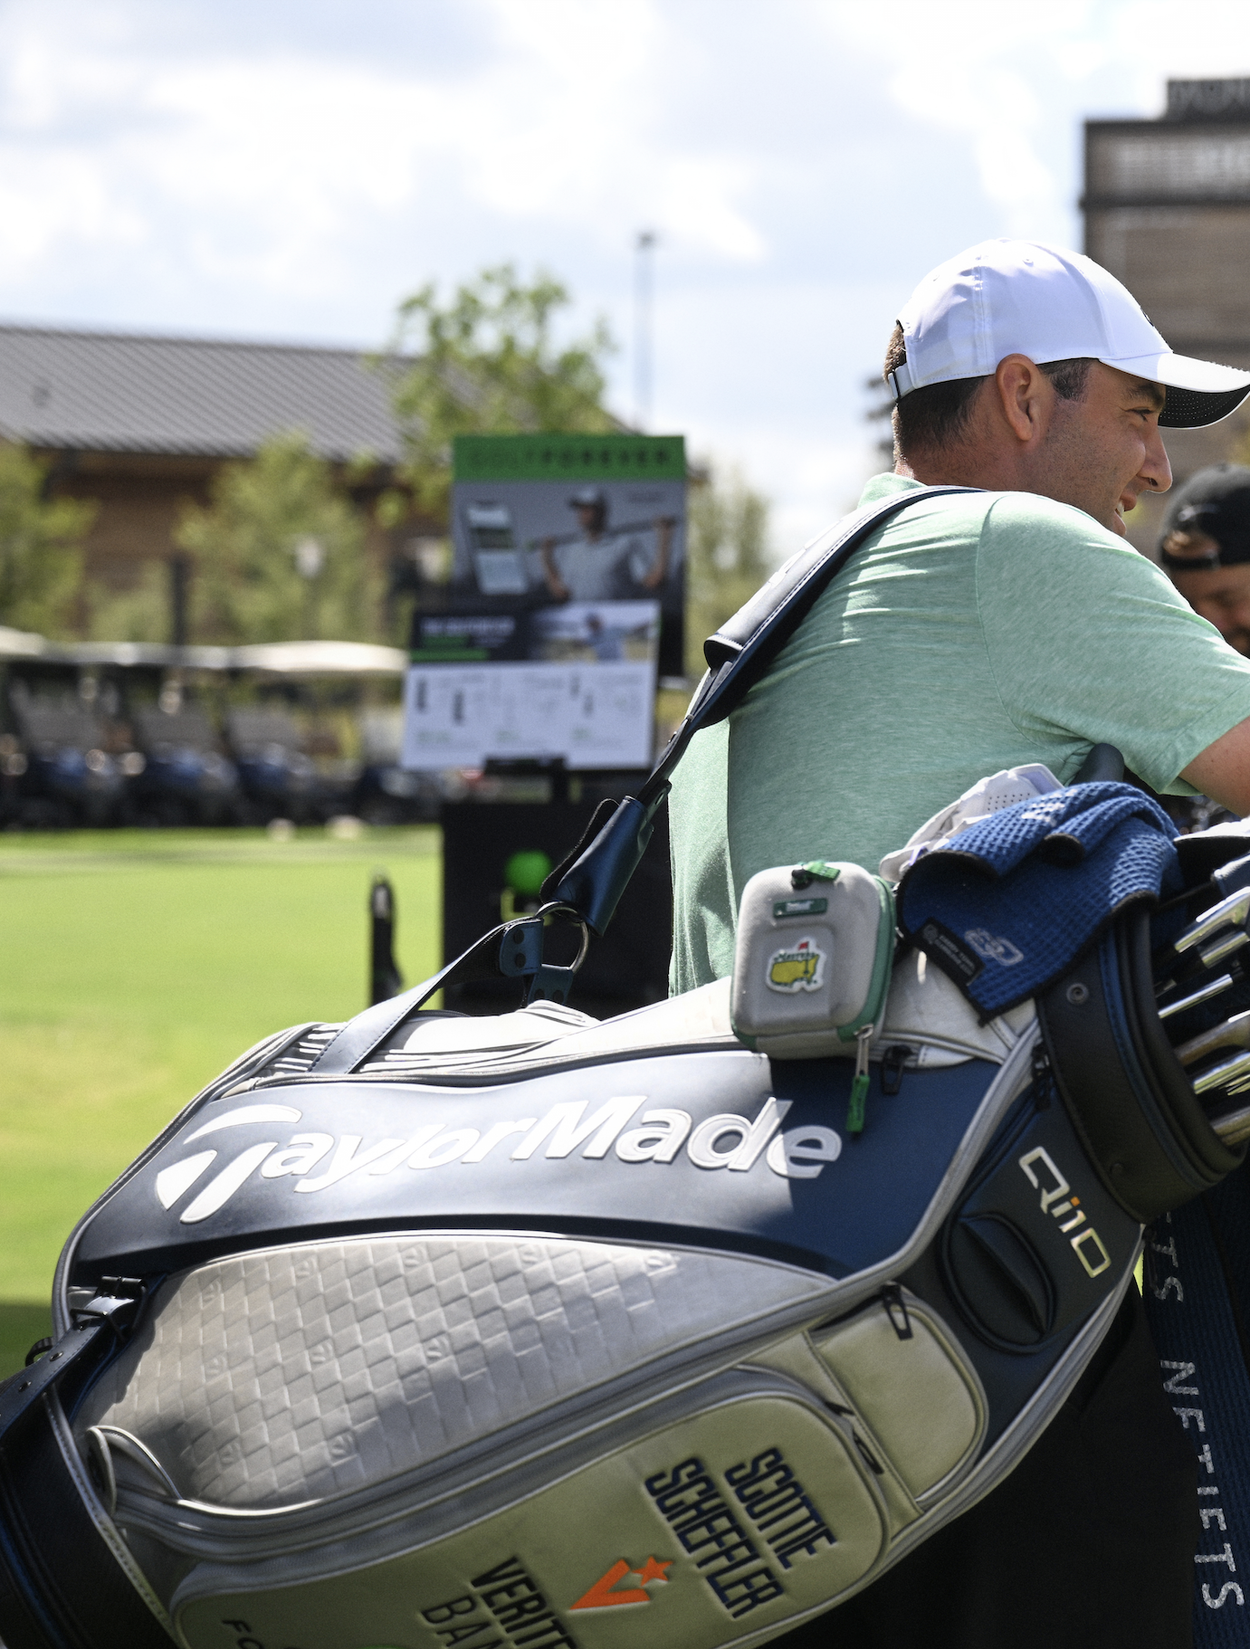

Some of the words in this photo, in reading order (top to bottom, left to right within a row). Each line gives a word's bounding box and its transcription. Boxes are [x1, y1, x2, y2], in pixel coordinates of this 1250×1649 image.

[156, 1094, 842, 1223] TaylorMade
[1019, 1146, 1111, 1278] Qi10
[644, 1457, 784, 1619] SCHEFFLER
[724, 1447, 837, 1570] SCOTTIE
